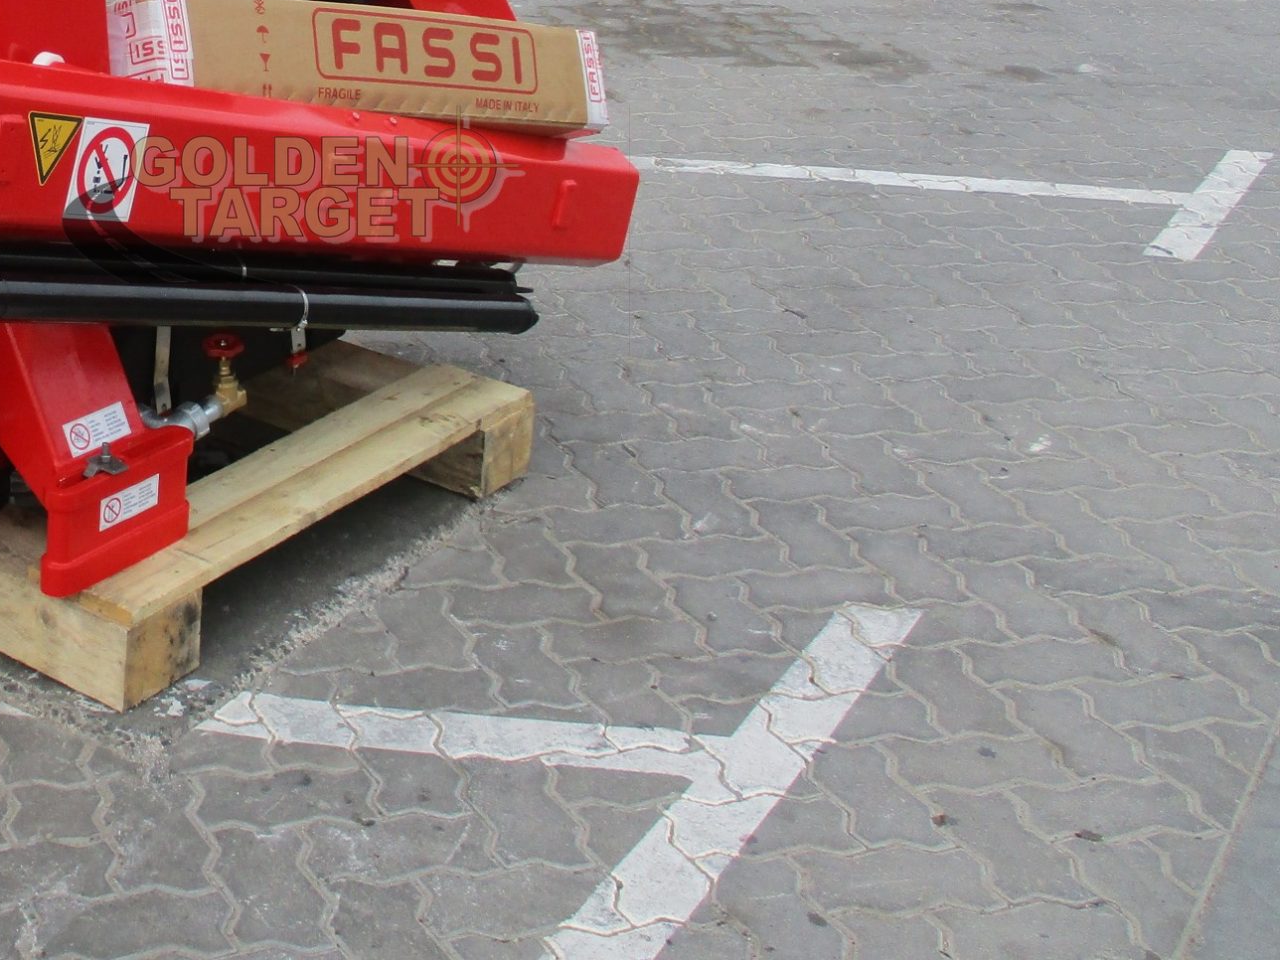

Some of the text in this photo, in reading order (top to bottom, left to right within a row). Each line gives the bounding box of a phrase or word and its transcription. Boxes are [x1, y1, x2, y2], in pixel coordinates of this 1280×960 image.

[331, 17, 523, 85] FASSI
[583, 36, 599, 96] FASSI
[318, 86, 361, 100] FRAGILE
[475, 97, 539, 113] MADE IN ITALY
